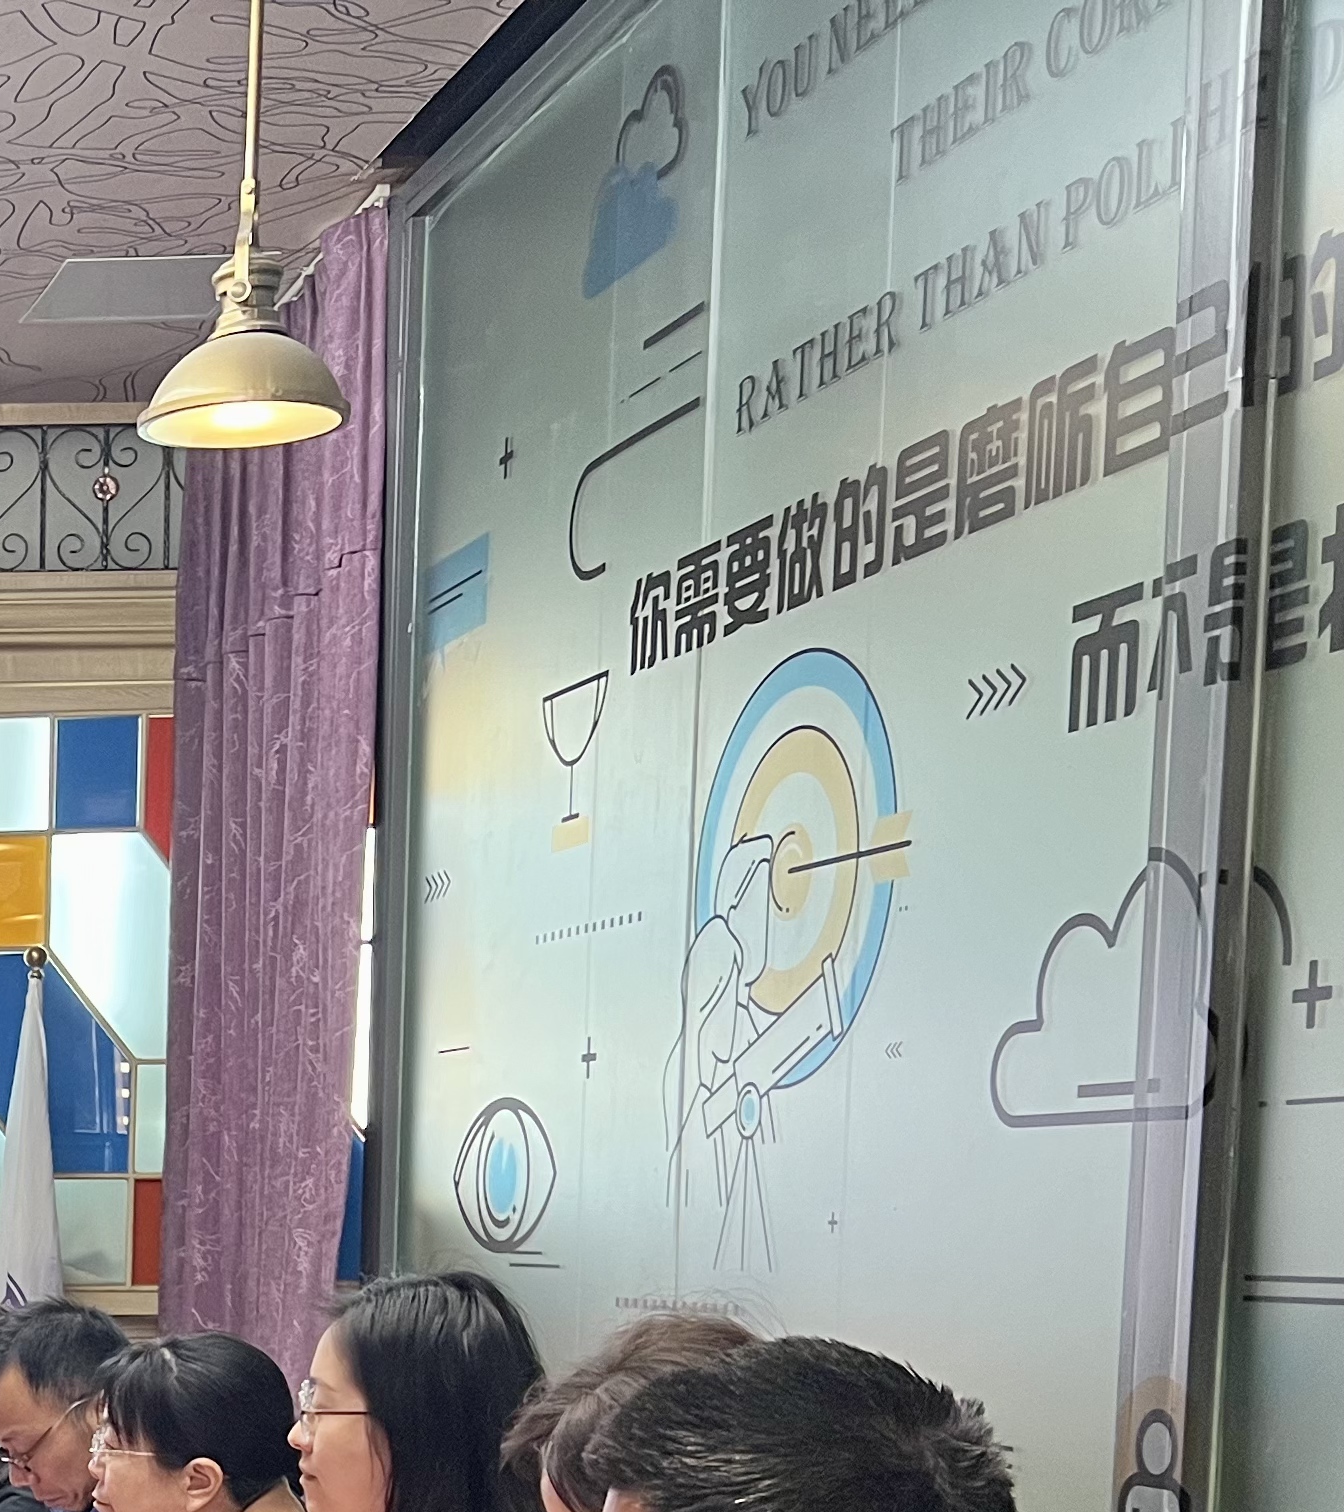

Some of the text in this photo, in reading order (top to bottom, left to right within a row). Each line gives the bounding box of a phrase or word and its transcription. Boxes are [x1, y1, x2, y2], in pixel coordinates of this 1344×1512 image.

[741, 33, 817, 138] YOU
[890, 41, 1034, 186] THEIR
[735, 290, 904, 437] RATHER
[914, 198, 1049, 332] THAN
